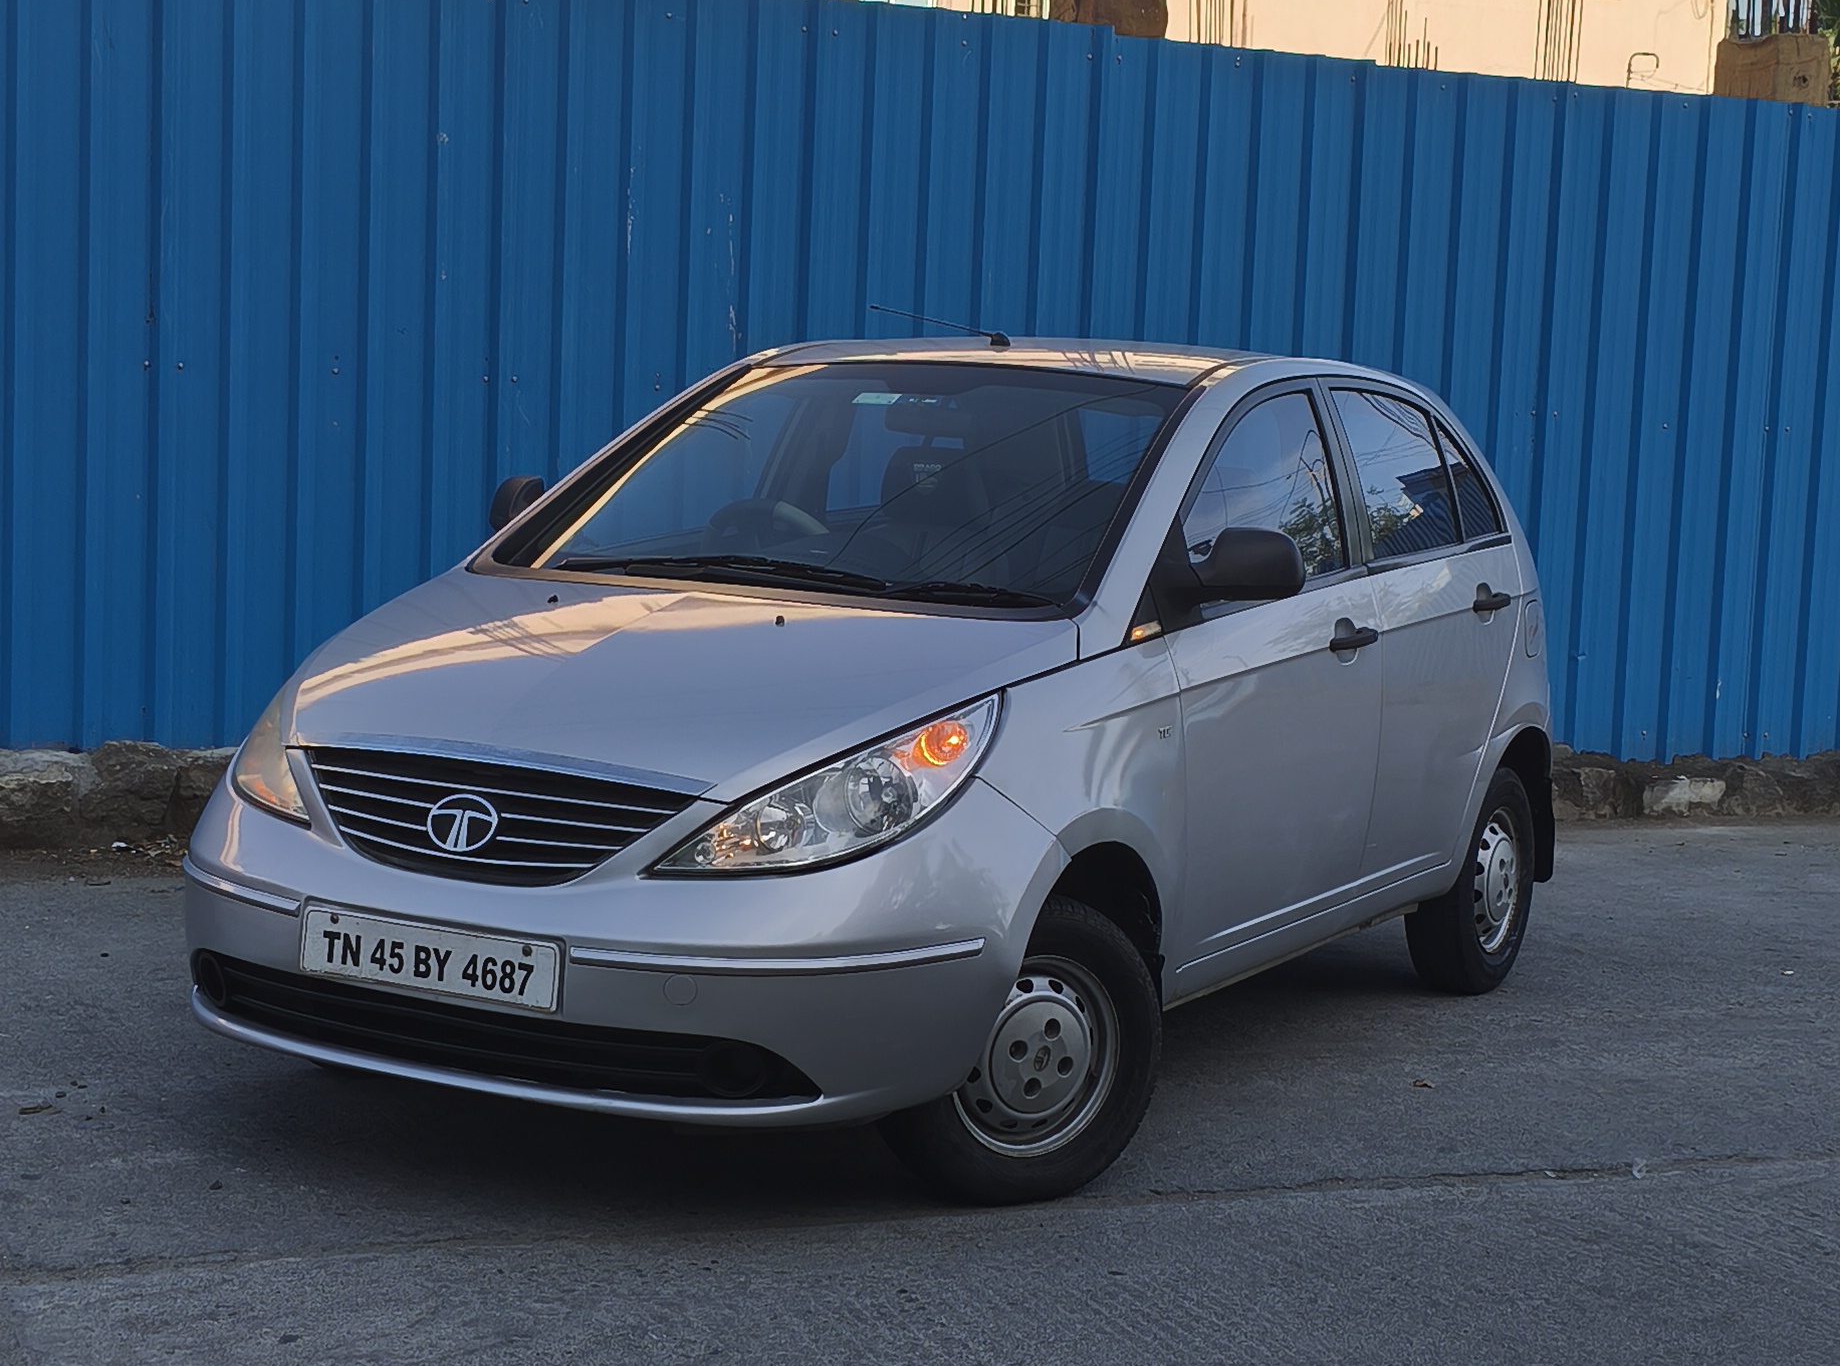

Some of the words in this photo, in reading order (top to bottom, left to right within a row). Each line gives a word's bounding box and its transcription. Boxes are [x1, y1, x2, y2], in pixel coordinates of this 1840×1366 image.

[323, 930, 362, 968] TN
[370, 938, 405, 975] 45
[413, 944, 453, 982] BY
[461, 953, 535, 997] 4687
